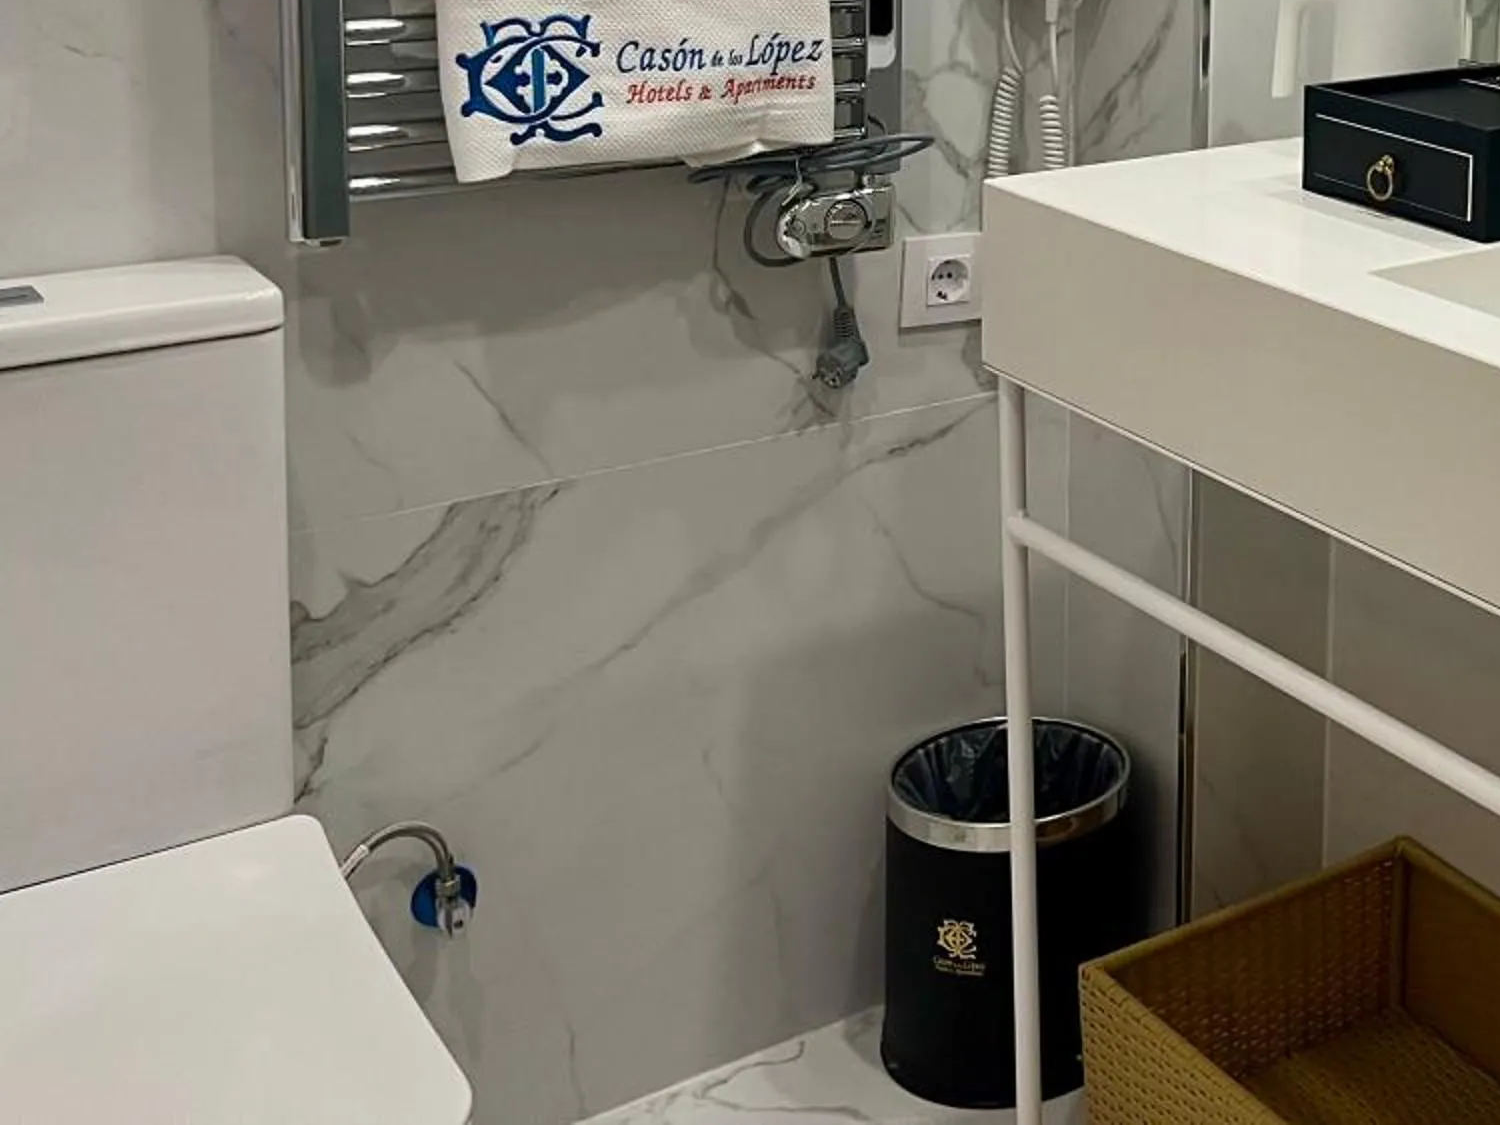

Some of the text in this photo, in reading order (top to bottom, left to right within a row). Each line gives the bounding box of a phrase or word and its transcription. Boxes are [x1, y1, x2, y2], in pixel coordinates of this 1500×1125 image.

[616, 32, 824, 75] Casón de los López
[626, 78, 693, 104] Hotels
[720, 74, 816, 105] Apartments
